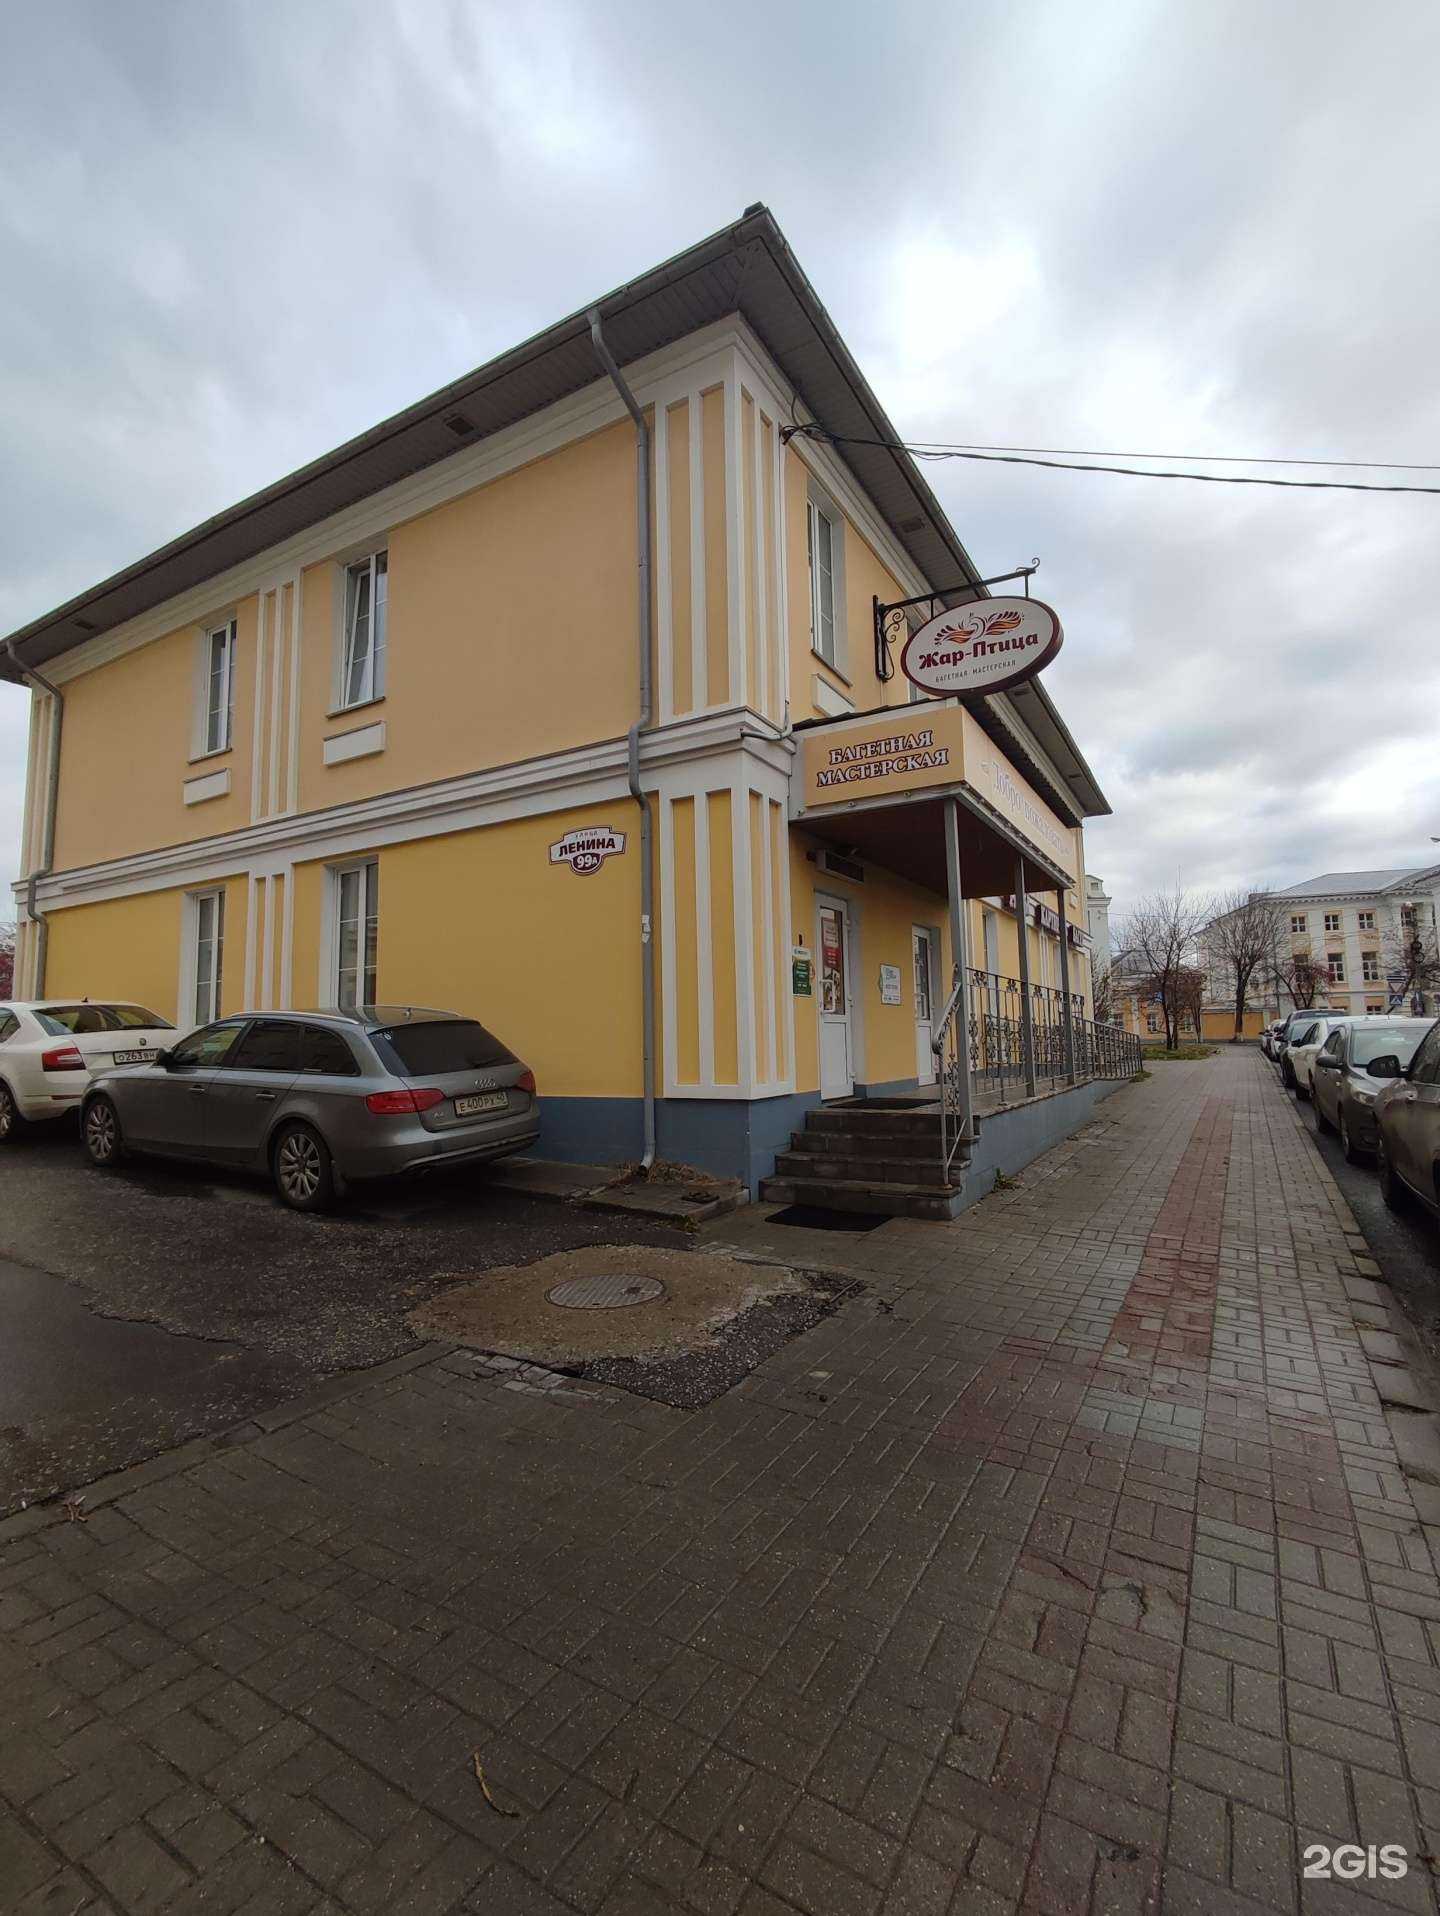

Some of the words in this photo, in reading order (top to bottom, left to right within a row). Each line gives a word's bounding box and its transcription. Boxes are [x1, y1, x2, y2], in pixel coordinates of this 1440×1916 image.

[919, 633, 1039, 670] Жар-Птица
[935, 670, 968, 683] БАГЕТНАЯ
[972, 659, 1016, 675] МАСТЕРСКАЯ
[829, 730, 933, 765] БАГЕТНАЯ
[817, 748, 949, 787] МАСТЕРСКАЯ
[559, 838, 615, 857] ЛЕНИНА
